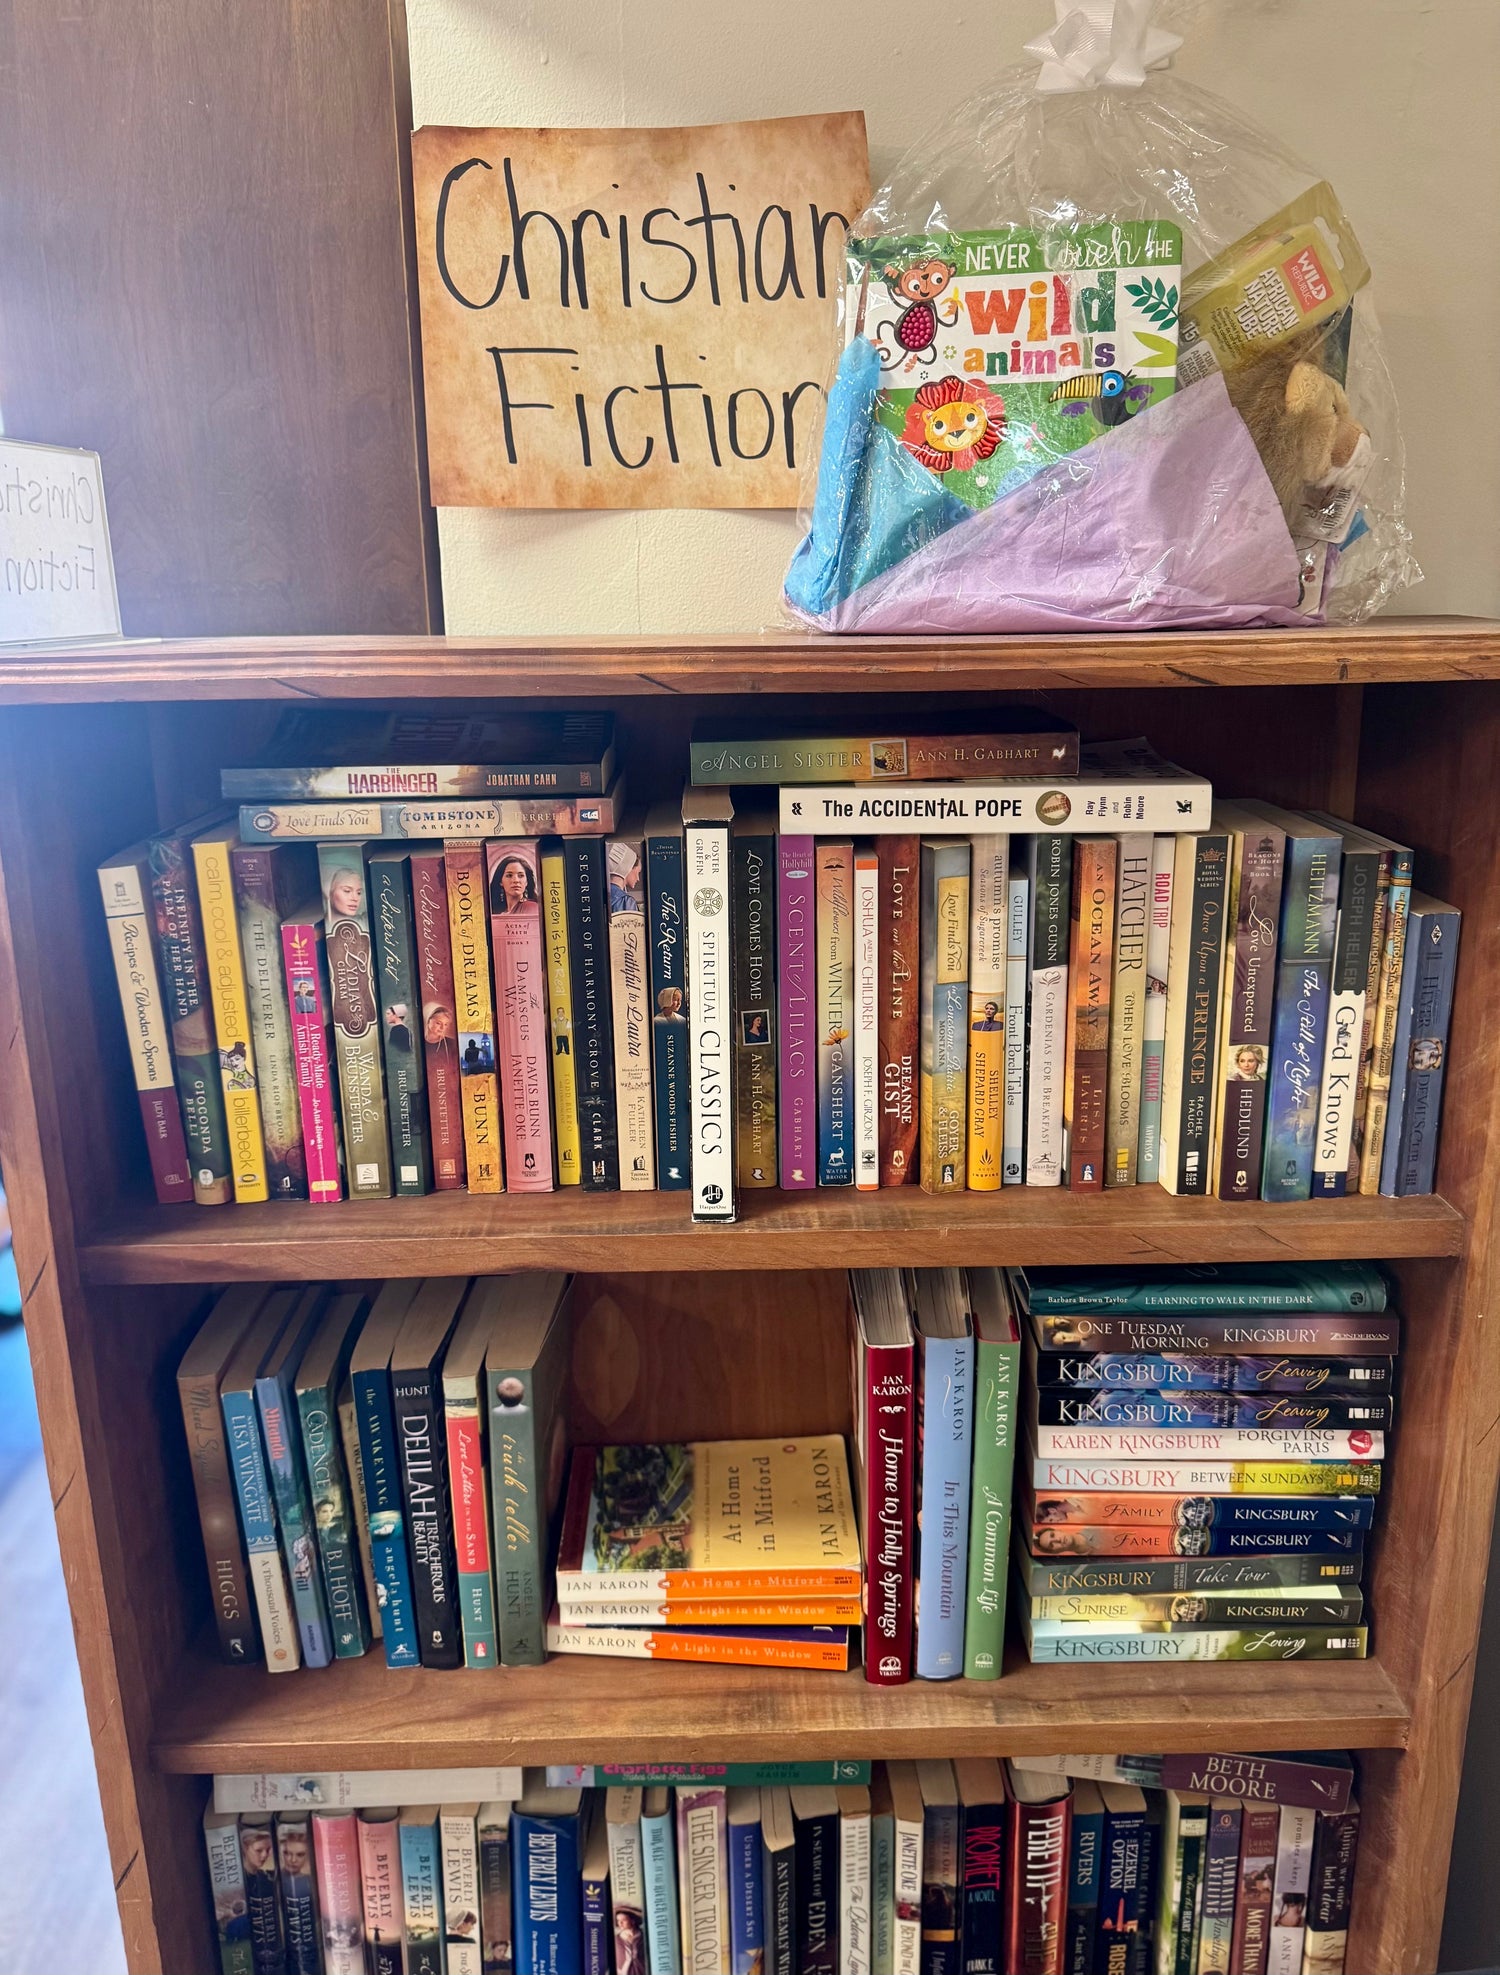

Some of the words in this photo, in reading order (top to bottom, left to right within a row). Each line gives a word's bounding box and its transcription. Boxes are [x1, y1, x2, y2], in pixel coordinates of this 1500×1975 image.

[965, 244, 1031, 271] NEVER
[1298, 249, 1327, 301] WILD
[964, 270, 1117, 342] wild
[1232, 300, 1254, 341] TUBE
[1244, 280, 1284, 339] NATURE
[1259, 266, 1299, 332] AFRICAN
[1182, 321, 1198, 343] 15
[964, 336, 1116, 376] animals
[701, 744, 783, 771] ANGEL
[793, 751, 863, 768] SISTER
[915, 748, 948, 762] ANN
[953, 748, 969, 762] H.
[974, 747, 1040, 760] GABHART
[348, 771, 438, 795] HARBINGER
[486, 774, 530, 787] JONATHAN
[533, 774, 557, 786] CAHN
[284, 812, 311, 830] Love
[313, 812, 346, 827] Finds
[343, 809, 375, 826] You
[404, 809, 495, 822] TOMBSTONE
[823, 800, 854, 817] The
[975, 800, 1022, 817] POPE
[1085, 800, 1094, 815] Ray
[1098, 796, 1107, 817] Flynn
[1123, 796, 1132, 819] Robin
[1136, 795, 1145, 820] Moore
[695, 838, 704, 876] GRIFFIN
[711, 840, 720, 874] FOSTER
[1049, 839, 1061, 878] ROBIN
[205, 857, 224, 904] calm,
[456, 871, 473, 925] BOOK
[550, 881, 564, 926] Heaven
[579, 854, 594, 924] SECRETS
[1048, 883, 1060, 920] JONES
[1154, 873, 1170, 903] ROAD
[1304, 853, 1327, 954] HEITZMANN
[212, 906, 228, 946] cool
[749, 899, 762, 951] COMES
[861, 886, 874, 937] JOSHUA
[1012, 895, 1023, 943] GULLEY
[1118, 857, 1148, 974] HATCHER
[120, 921, 144, 969] Recipes
[254, 921, 266, 953] THE
[659, 922, 677, 980] Return
[1048, 924, 1059, 961] GUNN
[336, 960, 348, 1000] CHARM
[462, 943, 480, 1017] DREAMS
[620, 932, 643, 989] Faithful
[701, 931, 717, 1023] SPIRITUAL
[750, 956, 763, 1000] HOME
[133, 988, 152, 1038] Wooden
[216, 966, 240, 1038] adjusted
[256, 957, 275, 1040] DELIVERER
[516, 961, 530, 1041] DAMASCUS
[584, 958, 597, 1031] HARMONY
[628, 992, 638, 1003] to
[827, 961, 843, 1031] WINTER
[861, 966, 874, 1031] CHILDREN
[1243, 957, 1261, 1033] Unexpected
[296, 1024, 311, 1054] Amish
[626, 1005, 644, 1058] Laura
[938, 1020, 946, 1068] MONTANA
[1007, 1005, 1023, 1039] Front
[1190, 990, 1210, 1084] PRINCE
[141, 1040, 160, 1082] Spoons
[298, 1056, 313, 1088] Family
[311, 1033, 325, 1089] Ready-Made
[526, 1055, 539, 1096] DAVIS
[588, 1039, 600, 1089] GROVE
[666, 1034, 675, 1079] SUZANNE
[863, 1056, 874, 1084] JOSEPH
[974, 1051, 987, 1106] SHEPARD
[1007, 1043, 1022, 1076] Porch
[345, 1046, 365, 1144] BRUNSTETTER
[510, 1054, 524, 1110] JANETTE
[699, 1030, 723, 1155] CLASSICS
[831, 1051, 843, 1140] GANSHERT
[883, 1063, 900, 1118] GIST
[989, 1070, 1000, 1120] SHELLEY
[1007, 1077, 1021, 1106] Tales
[185, 1098, 199, 1138] BELLI
[193, 1080, 212, 1154] GIOCONDA
[231, 1097, 253, 1170] billerbeck
[474, 1093, 488, 1145] BUNN
[514, 1114, 527, 1141] OKE
[528, 1099, 541, 1138] BUNN
[592, 1112, 603, 1150] CLARK
[792, 1097, 804, 1159] GABHART
[863, 1098, 874, 1141] GIRZONE
[949, 1110, 960, 1152] GOYER
[1187, 1100, 1197, 1136] HAUCK
[1194, 1096, 1204, 1139] RACHEL
[1236, 1088, 1253, 1159] HEDLUND
[1322, 1072, 1350, 1160] Knows
[1145, 1296, 1198, 1305] LEARNING
[1285, 1296, 1313, 1304] DARK
[1078, 1321, 1112, 1335] ONE
[1117, 1321, 1185, 1335] TUESDAY
[1131, 1336, 1209, 1349] MORNING
[1223, 1329, 1319, 1342] KINGSBURY
[1058, 1359, 1198, 1382] KINGSBURY
[952, 1384, 965, 1441] KARON
[306, 1410, 330, 1488] CADENCE
[1052, 1434, 1114, 1449] KAREN
[1119, 1434, 1223, 1454] KINGSBURY
[1237, 1429, 1336, 1444] FORGIVING
[1283, 1442, 1330, 1454] PARIS
[239, 1455, 262, 1523] WINGATE
[402, 1415, 435, 1517] DELILAH
[812, 1448, 834, 1515] KARON
[1047, 1465, 1181, 1488] KINGSBURY
[1191, 1471, 1257, 1484] BETWEEN
[1261, 1472, 1325, 1484] SUNDAYS
[722, 1465, 742, 1516] Home
[753, 1456, 774, 1534] Mitford
[885, 1497, 902, 1511] to
[1104, 1504, 1164, 1518] FAMILY
[1234, 1508, 1319, 1521] KINGSBURY
[878, 1511, 903, 1566] Holly
[982, 1511, 998, 1582] Common
[1114, 1533, 1161, 1547] FAME
[1230, 1534, 1312, 1546] KINGSBURY
[216, 1560, 240, 1619] HIGGS
[567, 1581, 592, 1592] JAN
[600, 1579, 649, 1590] KARON
[940, 1544, 958, 1620] Mountain
[1048, 1571, 1156, 1589] KINGSBURY
[472, 1588, 484, 1622] HUNT
[878, 1571, 902, 1638] Springs
[1058, 1598, 1128, 1616] SUNRISE
[1226, 1606, 1309, 1618] KINGSBURY
[1054, 1639, 1185, 1658] KINGSBURY
[1189, 1773, 1277, 1800] MOORE
[1206, 1757, 1266, 1779] BETH
[691, 1810, 714, 1846] THE
[211, 1846, 226, 1883] LEWIS
[222, 1836, 240, 1885] BEVERLY
[529, 1833, 558, 1884] BEVERLY
[692, 1846, 717, 1904] SINGER
[965, 1826, 1001, 1890] PROPHET
[1078, 1832, 1095, 1886] RIVERS
[1110, 1839, 1125, 1889] OPTION
[1123, 1844, 1139, 1893] EZEKIEL
[408, 1876, 419, 1918] LEWIS
[419, 1855, 434, 1919] BEVERLY
[529, 1885, 558, 1921] LEWIS
